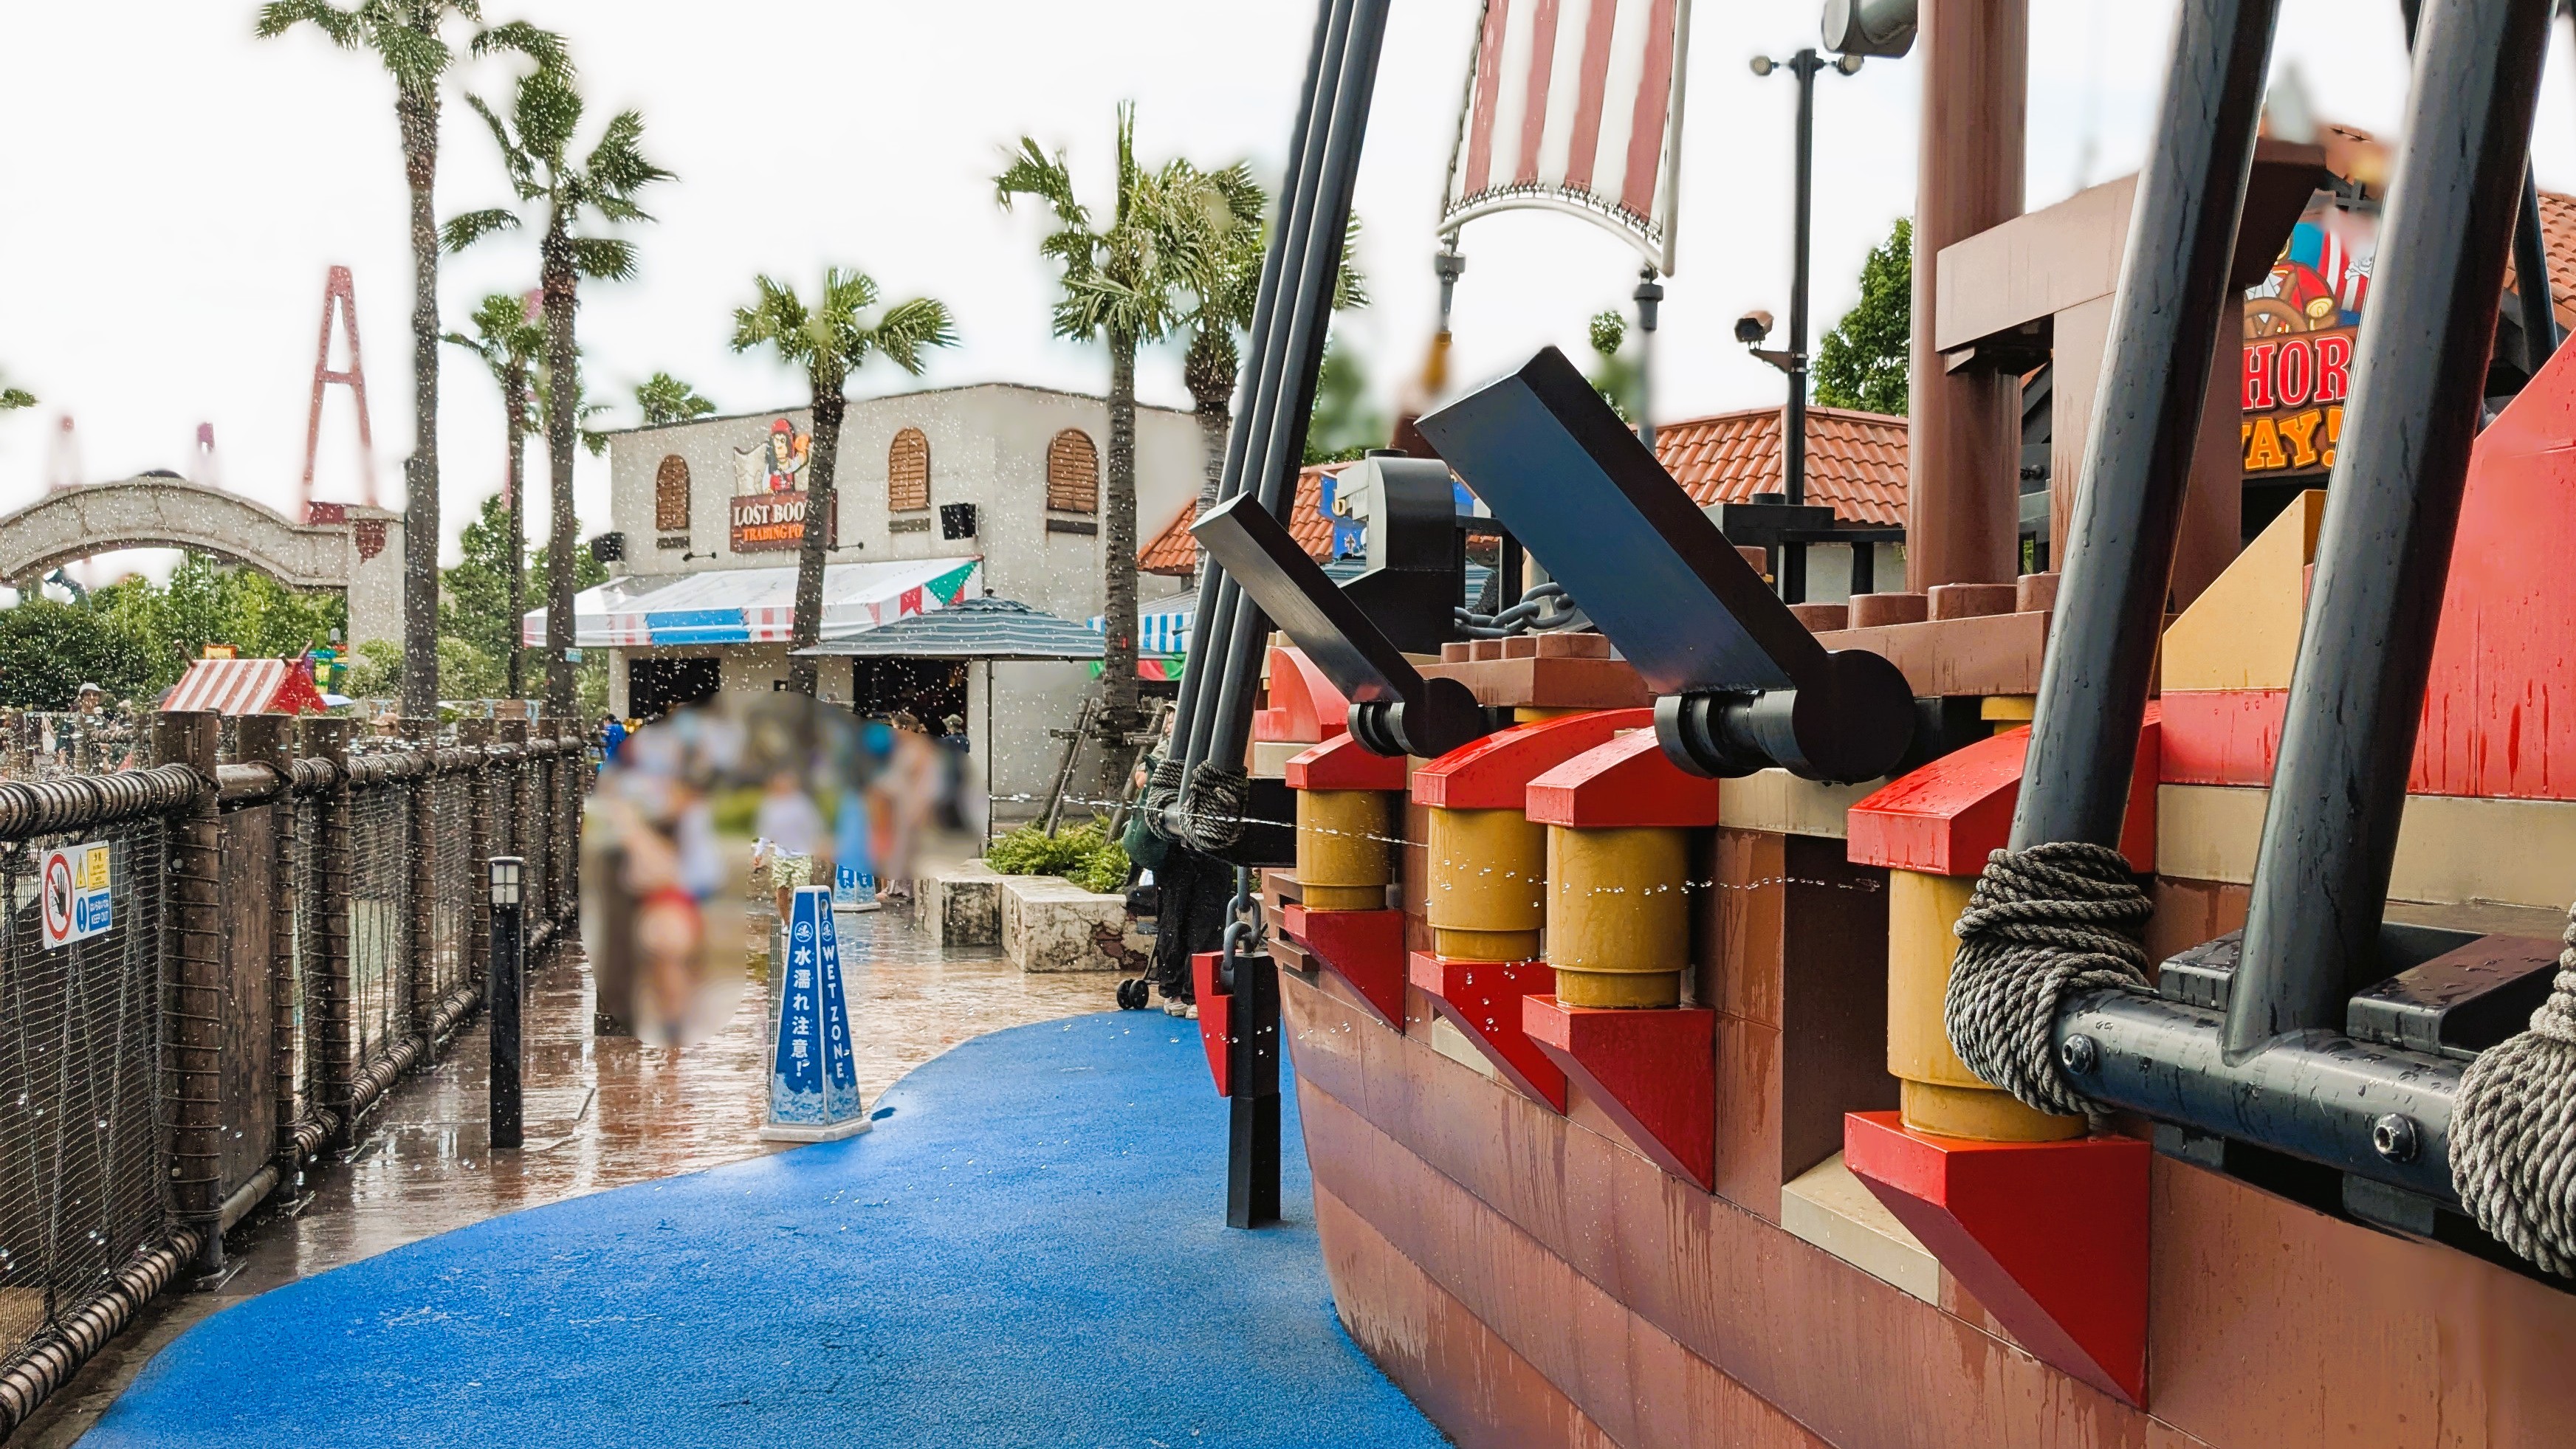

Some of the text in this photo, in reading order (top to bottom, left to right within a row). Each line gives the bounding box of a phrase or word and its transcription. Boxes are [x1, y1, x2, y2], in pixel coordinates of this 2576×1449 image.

[2242, 408, 2343, 469] AY!
[734, 501, 806, 526] LOST BOO
[743, 523, 805, 542] TRADING PO
[822, 945, 844, 1079] WET ZONE
